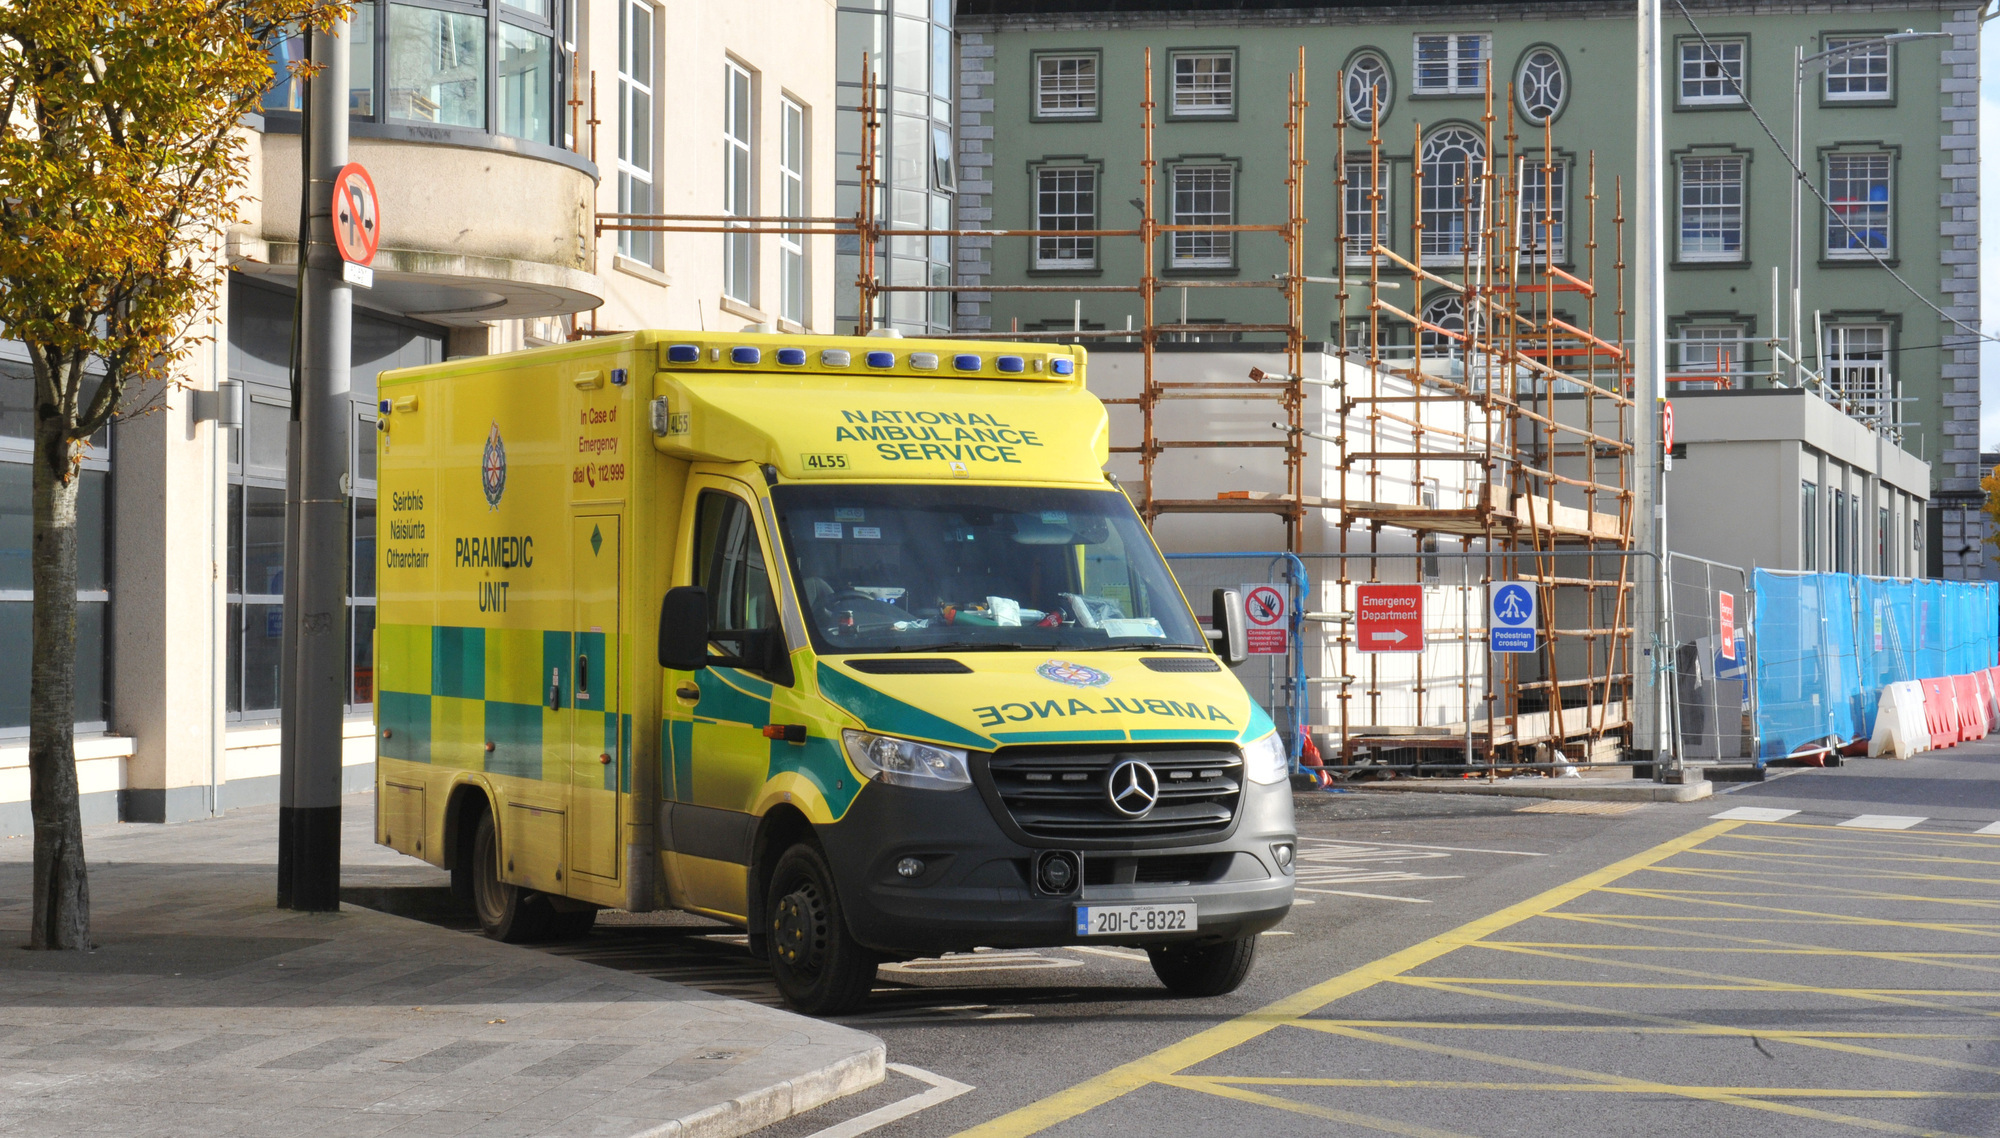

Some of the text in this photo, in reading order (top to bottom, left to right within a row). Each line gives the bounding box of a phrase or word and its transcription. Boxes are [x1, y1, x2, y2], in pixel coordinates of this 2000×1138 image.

[349, 185, 364, 246] P
[580, 405, 617, 425] In Case of
[670, 415, 688, 433] 4L55
[841, 410, 1010, 427] NATIONAL
[579, 436, 618, 456] Emergency
[836, 426, 1044, 447] AMBULANCE
[808, 455, 846, 468] 4L55
[876, 443, 1022, 463] SERVICE
[573, 466, 585, 484] dial
[393, 489, 424, 511] Seirbhís
[390, 518, 425, 540] Náisiúnta
[386, 548, 429, 568] Otharchairr
[455, 535, 533, 568] PARAMEDIC
[478, 581, 510, 613] UNIT
[1362, 595, 1417, 608] Emergency
[1361, 609, 1418, 622] Department
[1495, 631, 1532, 639] Pedestrian
[1498, 640, 1528, 648] crossing
[1078, 923, 1088, 931] IRL
[1097, 909, 1186, 932] 201-C-8322
